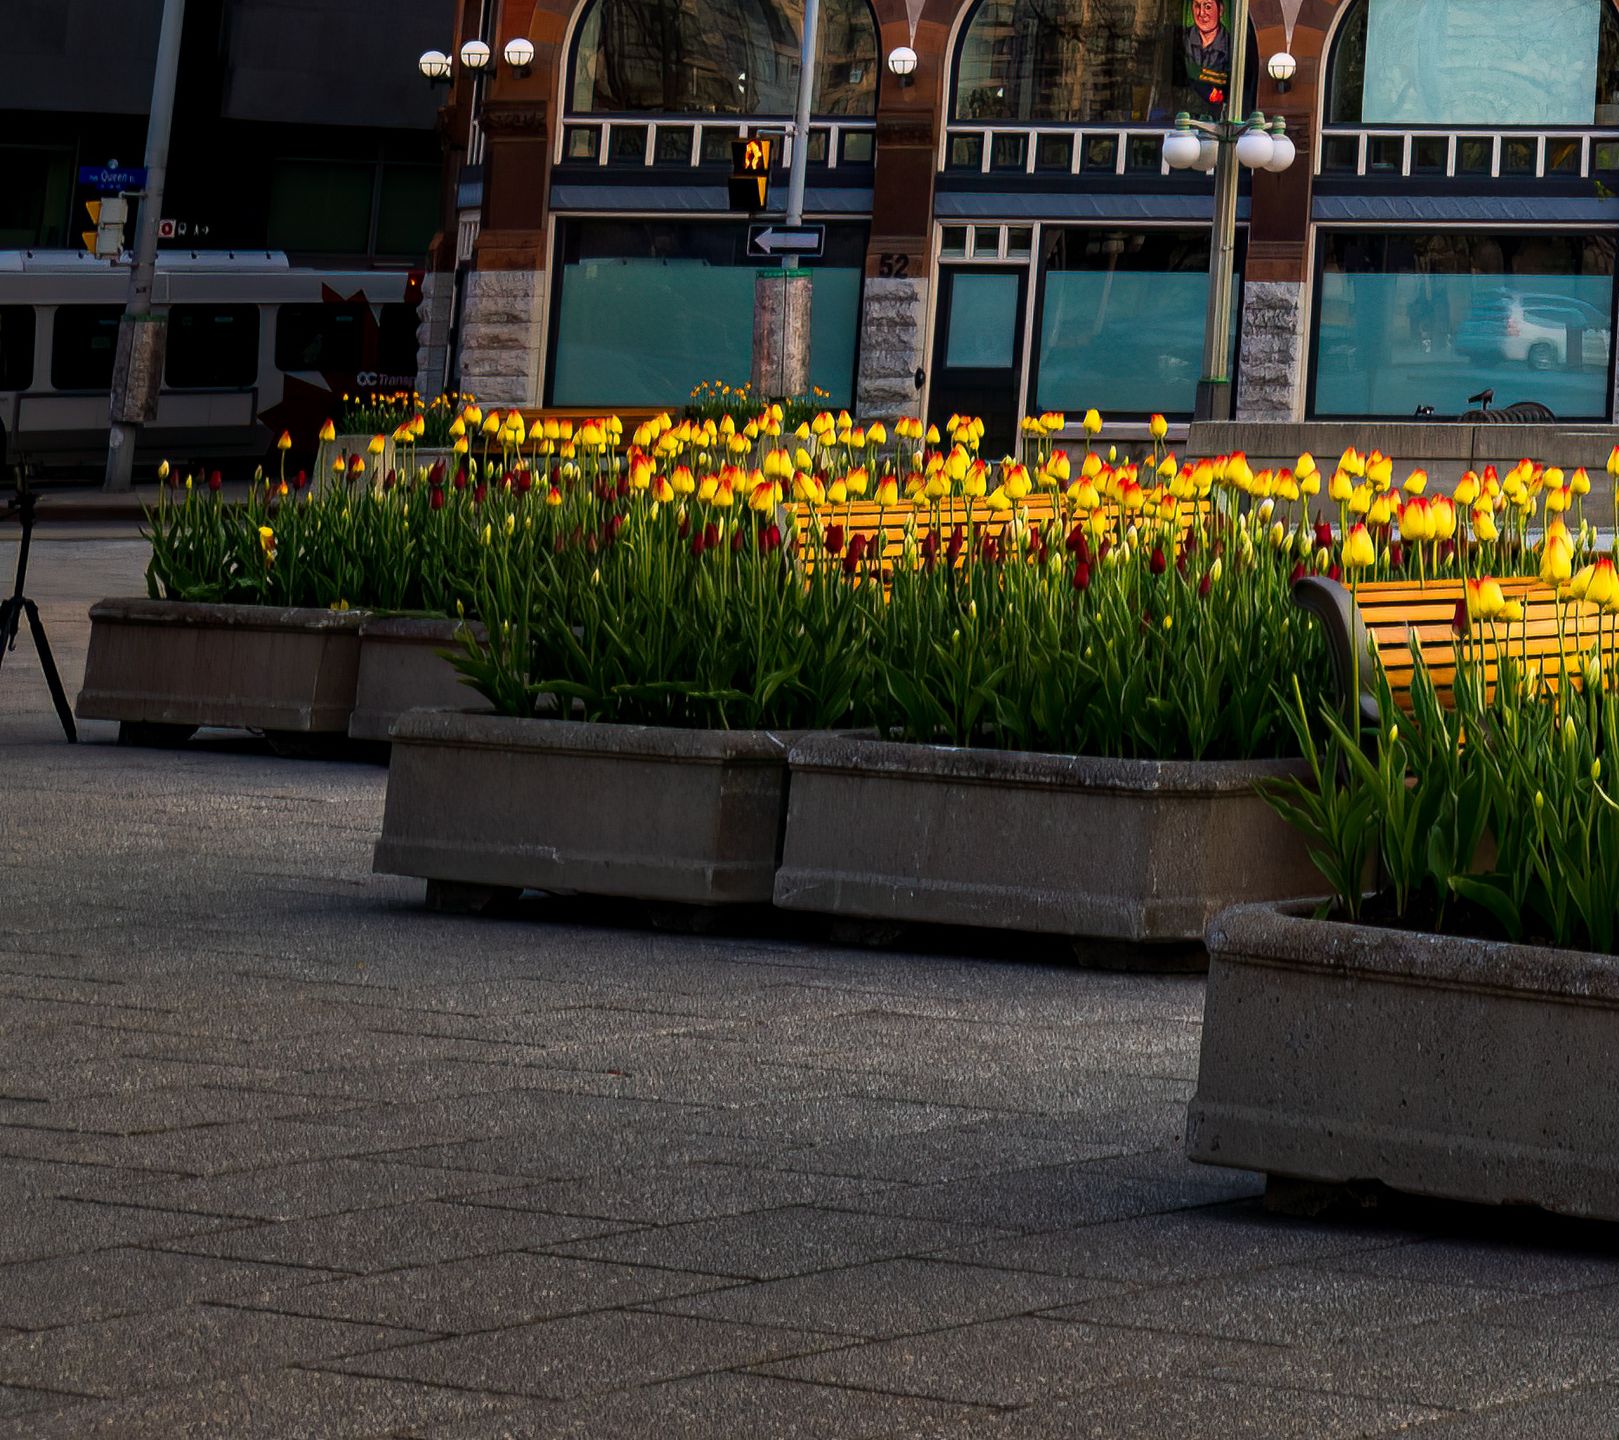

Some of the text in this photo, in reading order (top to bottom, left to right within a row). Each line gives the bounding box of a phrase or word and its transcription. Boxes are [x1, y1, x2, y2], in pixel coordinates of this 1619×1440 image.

[100, 169, 128, 184] Queen
[879, 253, 909, 279] 52
[356, 370, 379, 387] OC
